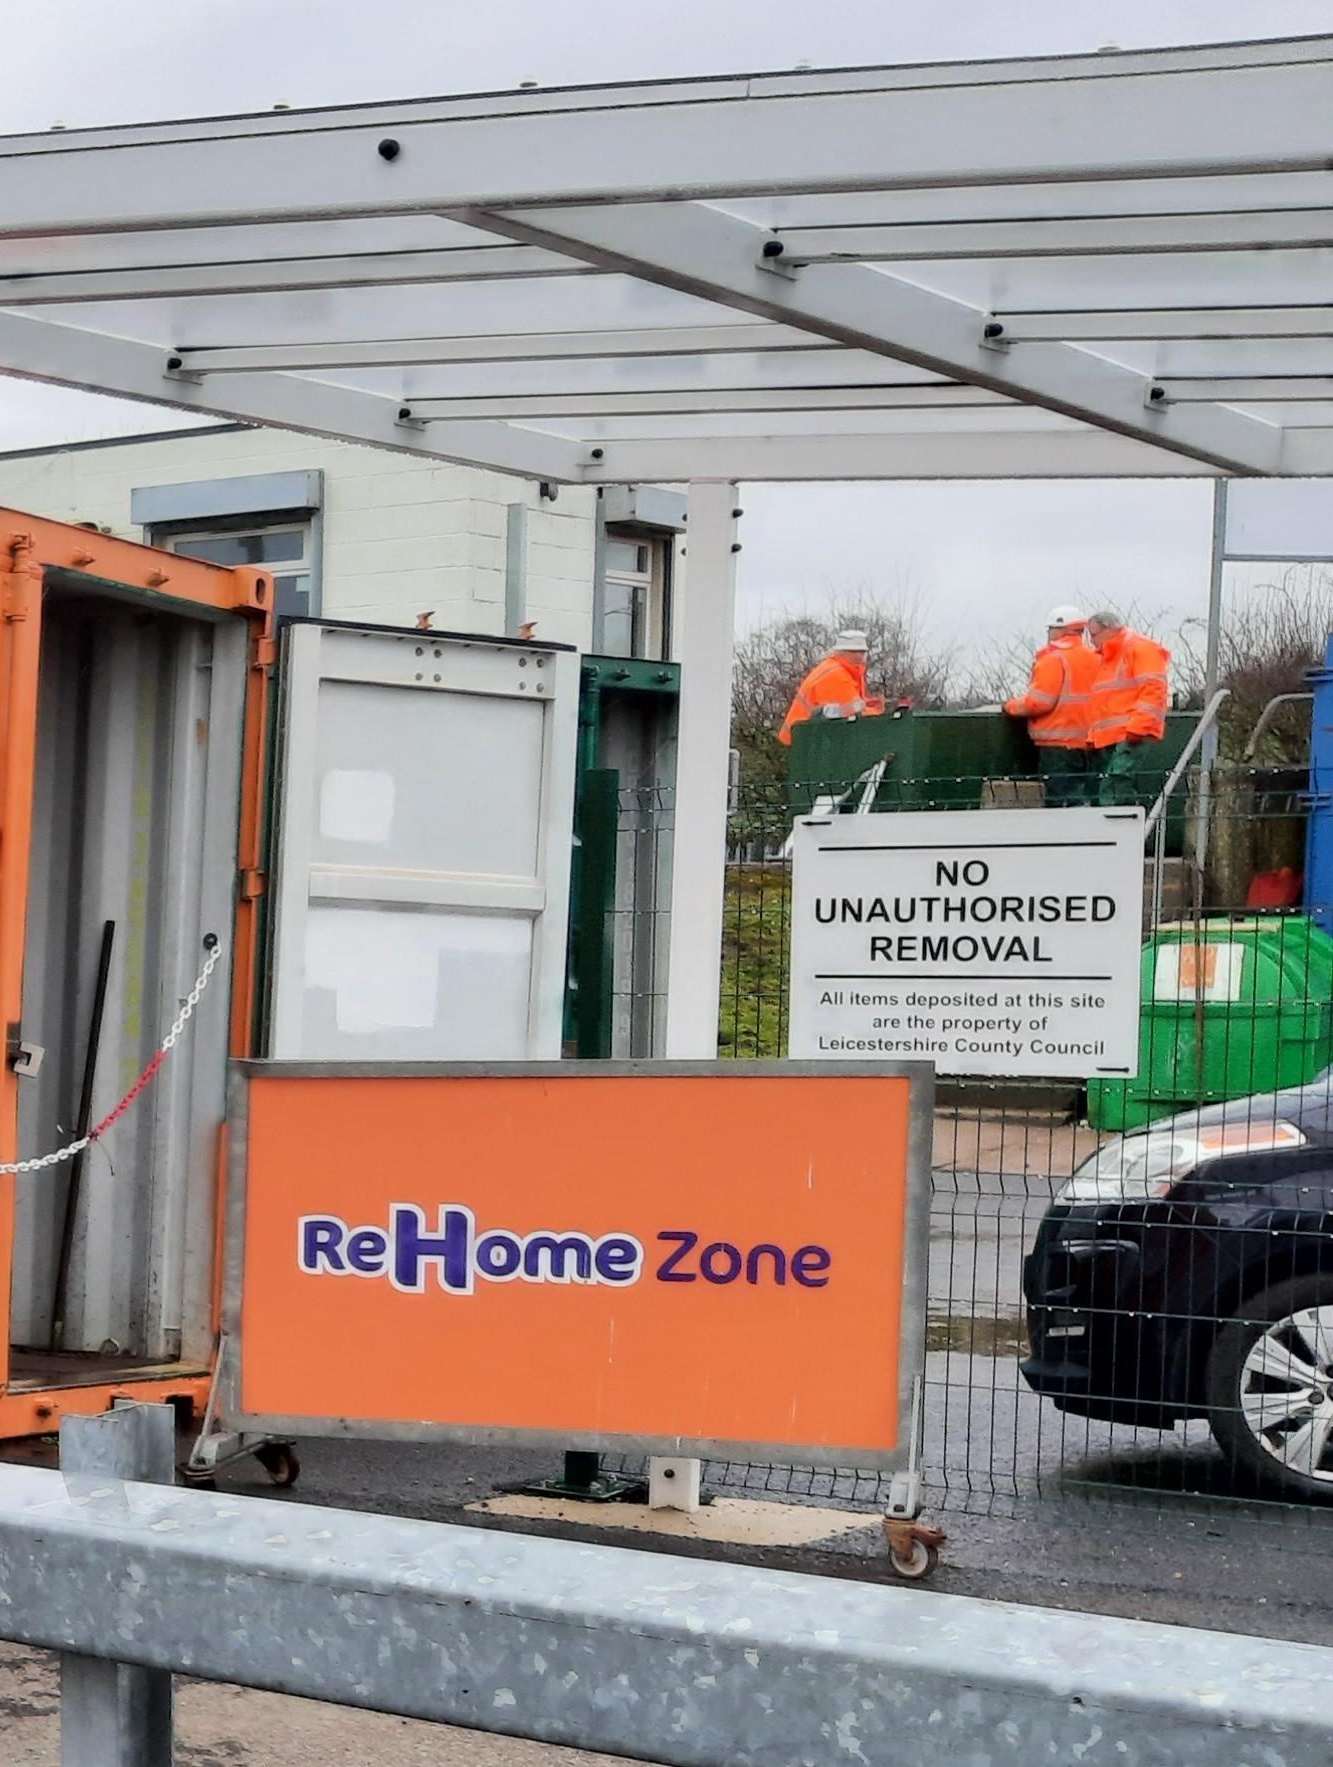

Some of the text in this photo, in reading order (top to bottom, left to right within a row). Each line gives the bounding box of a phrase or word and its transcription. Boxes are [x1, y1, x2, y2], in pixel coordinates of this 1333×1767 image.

[936, 860, 989, 887] NO
[815, 895, 1116, 924] UNAUTHORISED
[870, 935, 1053, 962] REMOVAL
[820, 991, 1105, 1009] All items deposited at this site
[872, 1015, 1048, 1034] are the property of
[819, 1036, 1104, 1057] Leicestershire County Council
[297, 1202, 830, 1295] ReHome Zone
